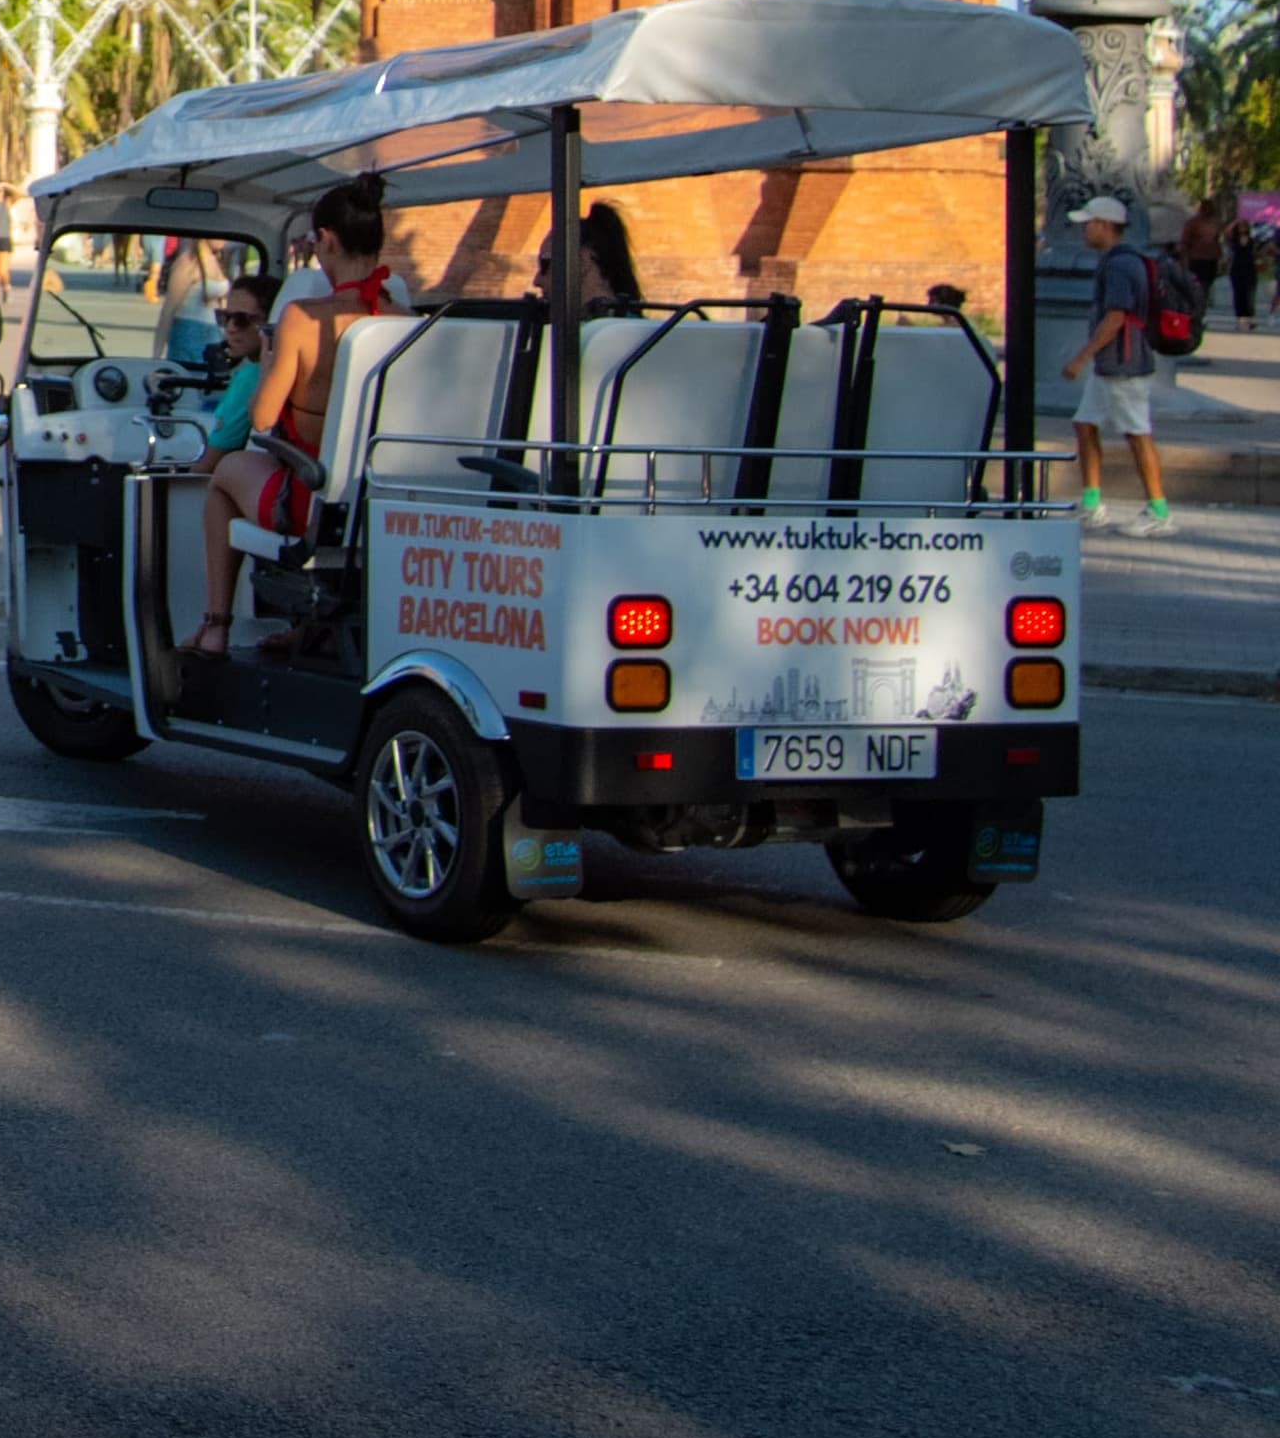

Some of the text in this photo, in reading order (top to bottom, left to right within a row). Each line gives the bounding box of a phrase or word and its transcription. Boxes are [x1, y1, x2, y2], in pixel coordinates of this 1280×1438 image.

[384, 511, 561, 550] WWW.TUKTUK-BCN.COM
[699, 522, 984, 551] www.tuktuk-bcn.com
[402, 546, 544, 598] CITY TOURS
[729, 574, 951, 604] +34 604 219 676
[399, 595, 545, 651] BARCELONA
[757, 616, 920, 645] BOOK NOW!
[763, 734, 926, 772] 7659 NDF
